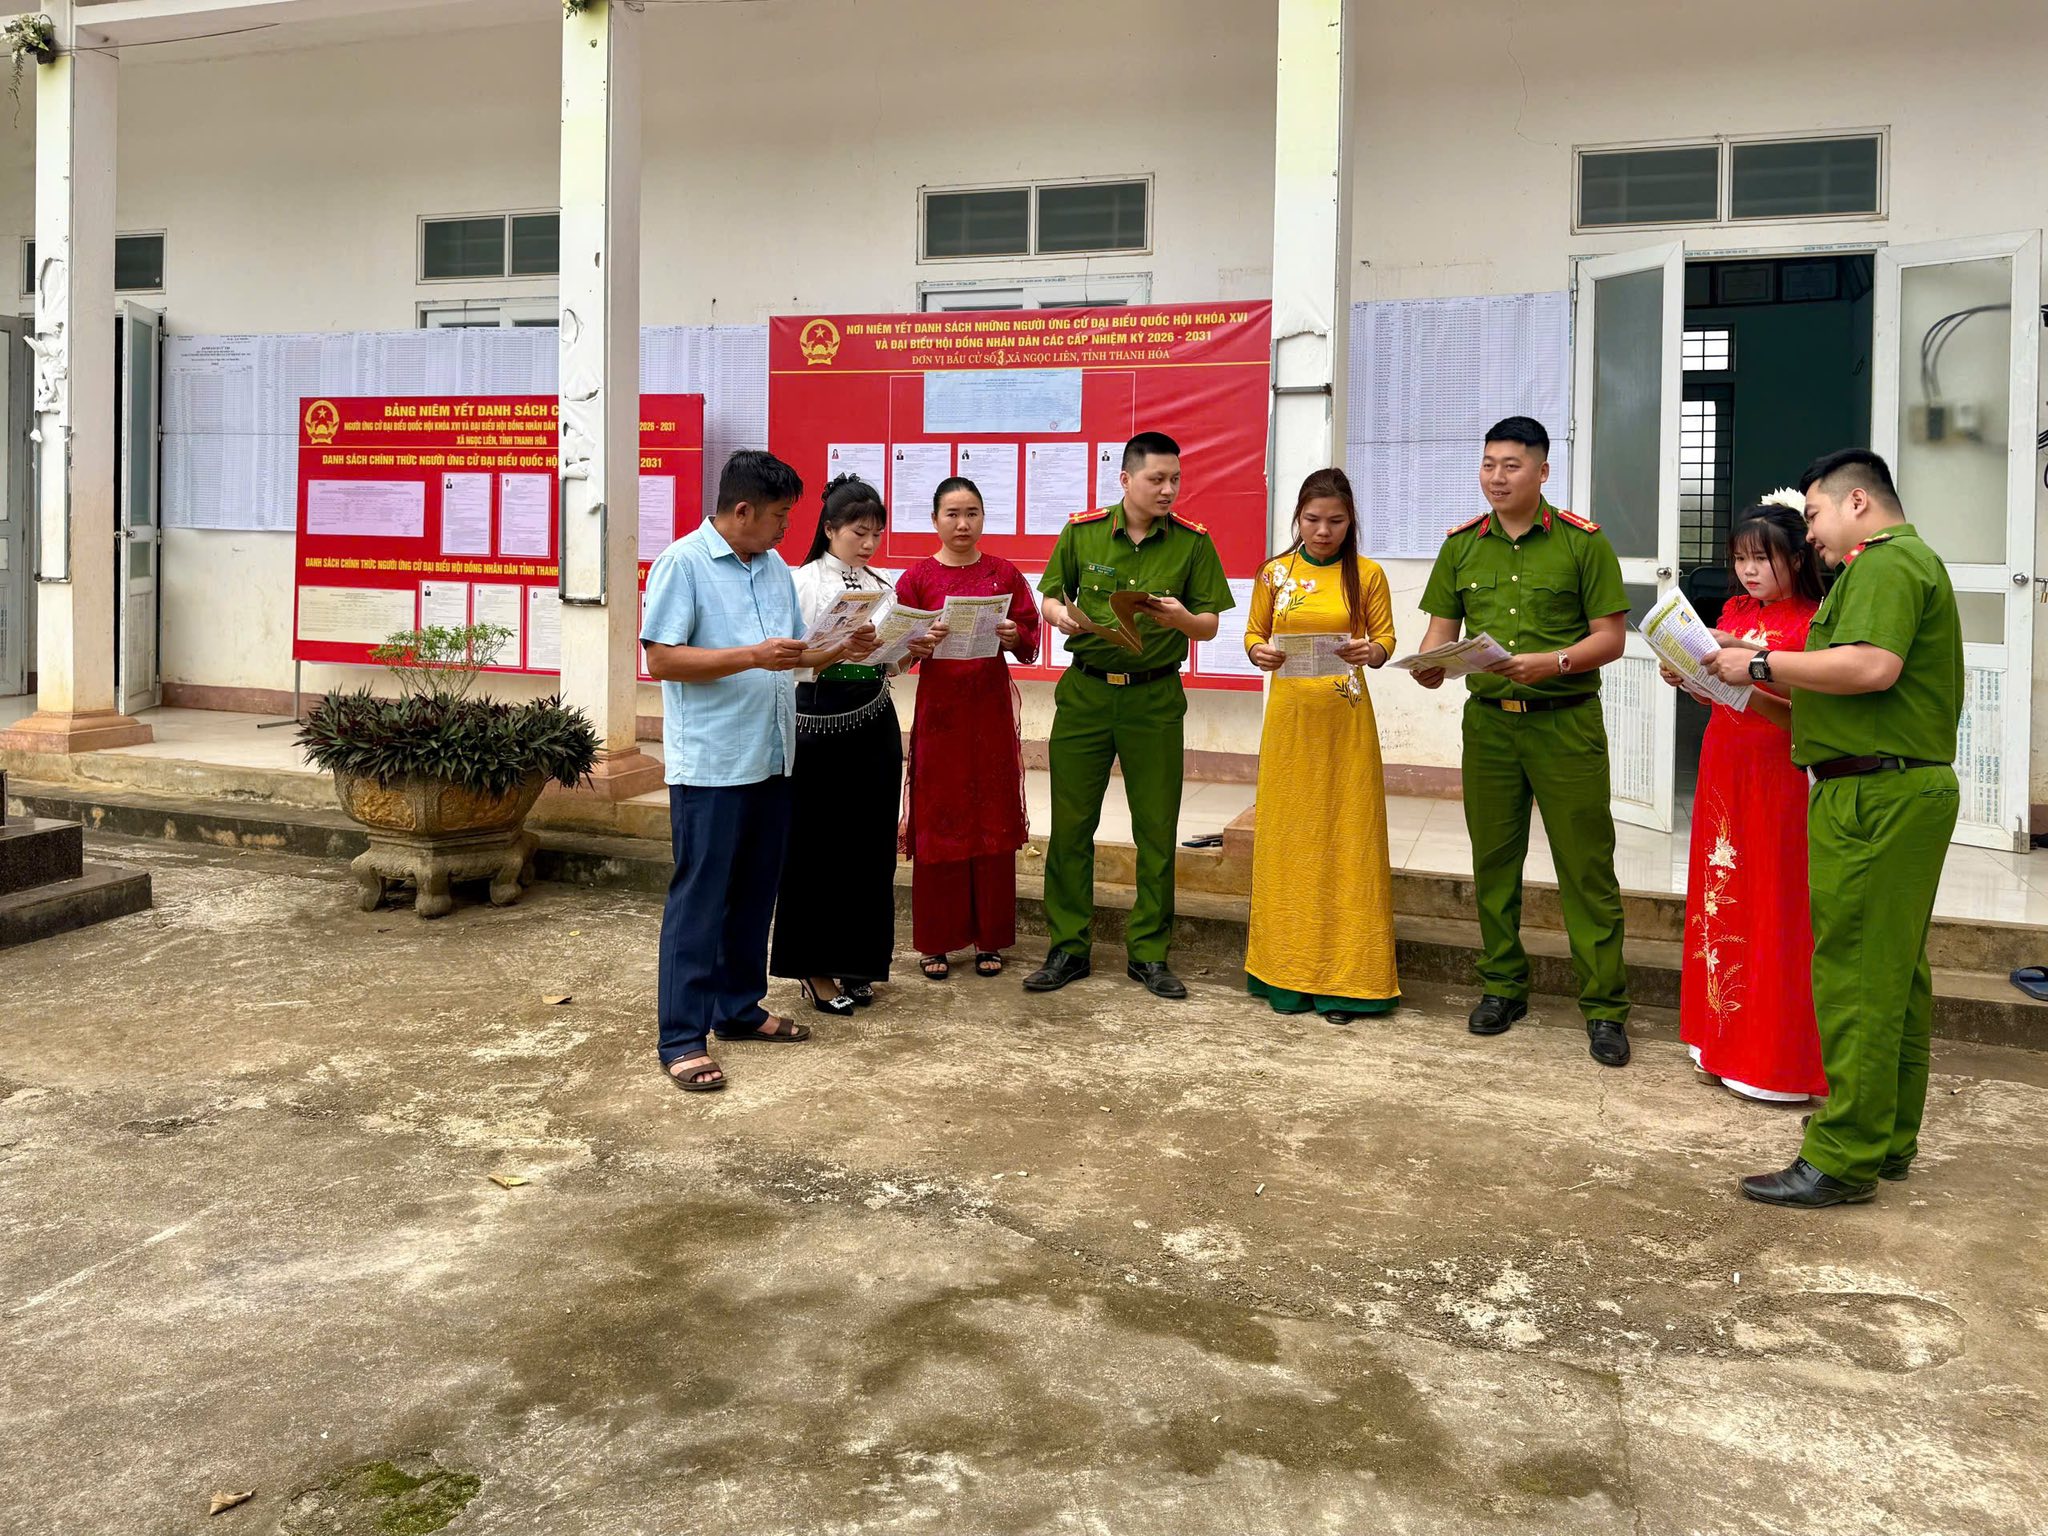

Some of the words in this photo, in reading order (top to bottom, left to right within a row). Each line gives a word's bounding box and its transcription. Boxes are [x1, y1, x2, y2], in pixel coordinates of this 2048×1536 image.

[846, 325, 864, 334] NƠI
[866, 322, 892, 334] NIÊM
[894, 320, 912, 334] YẾT
[915, 324, 942, 333] DANH
[944, 320, 971, 333] SÁCH
[975, 319, 1010, 332] NHỮNG
[1013, 318, 1045, 331] NGƯỜI
[1048, 317, 1070, 329] ỨNG
[1074, 316, 1090, 329] CỬ
[1091, 319, 1109, 330] ĐẠI
[1112, 314, 1137, 327] BIỂU
[1140, 313, 1169, 326] QUỐC
[1173, 313, 1191, 327] HỘI
[1195, 311, 1226, 324] KHÓA
[1229, 313, 1248, 322] XVI
[875, 338, 888, 349] VÀ
[890, 340, 907, 351] ĐẠI
[910, 335, 933, 349] BIỂU
[935, 336, 952, 351] HỘI
[956, 335, 983, 348] ĐỒNG
[986, 335, 1015, 347] NHÂN
[1018, 335, 1040, 347] DÂN
[1043, 334, 1064, 346] CÁC
[1067, 332, 1088, 345] CẤP
[1091, 332, 1126, 346] NHIỆM
[1130, 331, 1144, 343] KỲ
[1148, 333, 1174, 342] 2026
[1185, 332, 1212, 341] 2031
[912, 355, 933, 364] ĐƠN
[935, 355, 945, 366] VỊ
[947, 351, 966, 364] BẦU
[969, 352, 982, 363] CỬ
[984, 351, 996, 363] SỐ
[1023, 354, 1050, 364] NGỌC
[1053, 350, 1080, 363] LIÊN,
[1082, 350, 1106, 361] TỈNH
[1110, 351, 1144, 360] THANH
[1148, 348, 1170, 359] HÓA
[384, 403, 416, 416] BẢNG
[419, 403, 450, 416] NIÊM
[453, 402, 474, 416] YẾT
[478, 405, 511, 416] DANH
[514, 403, 547, 416] SÁCH
[322, 455, 344, 464] DANH
[346, 453, 367, 465] SÁCH
[369, 453, 394, 465] CHÍNH
[396, 452, 417, 465] THỨC
[419, 453, 445, 465] NGƯỜI
[447, 453, 464, 465] ỨNG
[467, 453, 480, 465] CỬ
[481, 456, 495, 468] ĐẠI
[498, 452, 517, 466] BIỂU
[520, 452, 543, 466] QUỐC
[545, 454, 558, 469] HỘ
[640, 458, 662, 468] 2031
